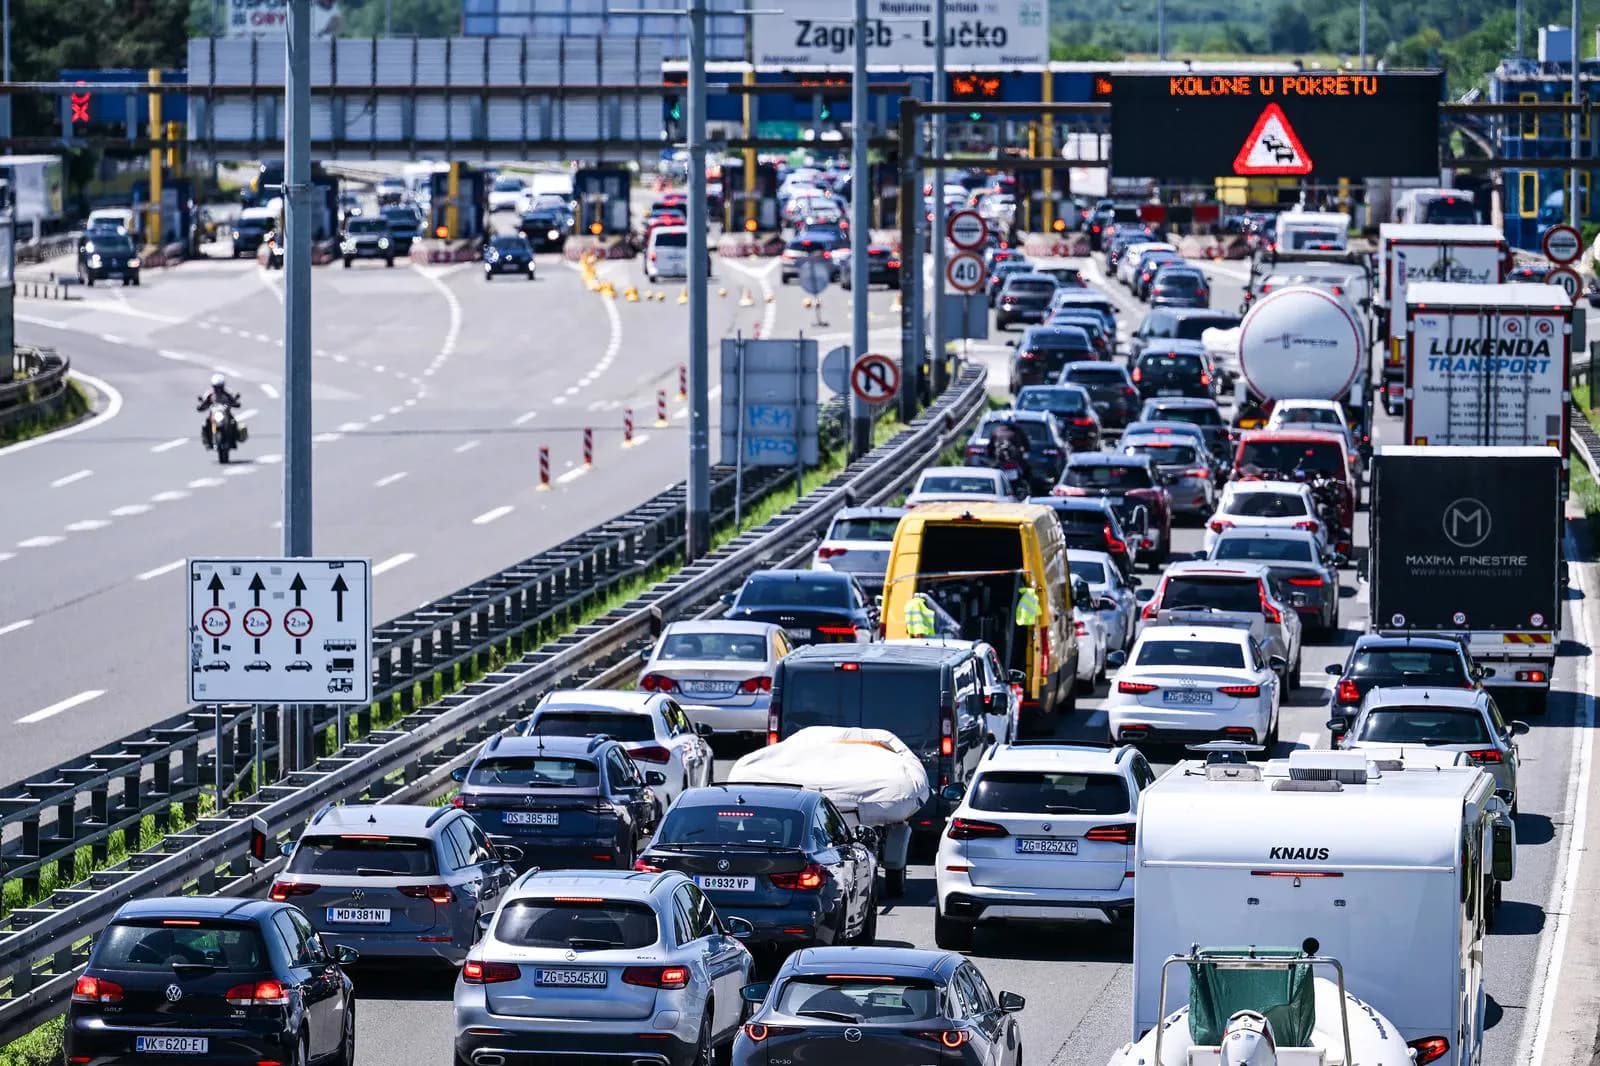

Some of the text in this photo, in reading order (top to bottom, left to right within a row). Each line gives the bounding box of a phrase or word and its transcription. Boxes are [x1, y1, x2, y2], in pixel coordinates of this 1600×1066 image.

[1170, 76, 1378, 96] KOLONE U POKRETU
[955, 263, 977, 280] 40
[1429, 337, 1551, 357] LUKENDA
[1428, 358, 1551, 374] TRANSPORT
[1452, 507, 1481, 537] M
[1406, 555, 1528, 566] MAXIMA FINESTRE
[507, 813, 519, 823] OS
[1023, 840, 1034, 851] ZG
[1269, 847, 1329, 860] KNAUS
[704, 878, 749, 889] G 932 VP
[337, 910, 350, 920] MD
[543, 971, 557, 983] ZG
[145, 1038, 158, 1050] VK
